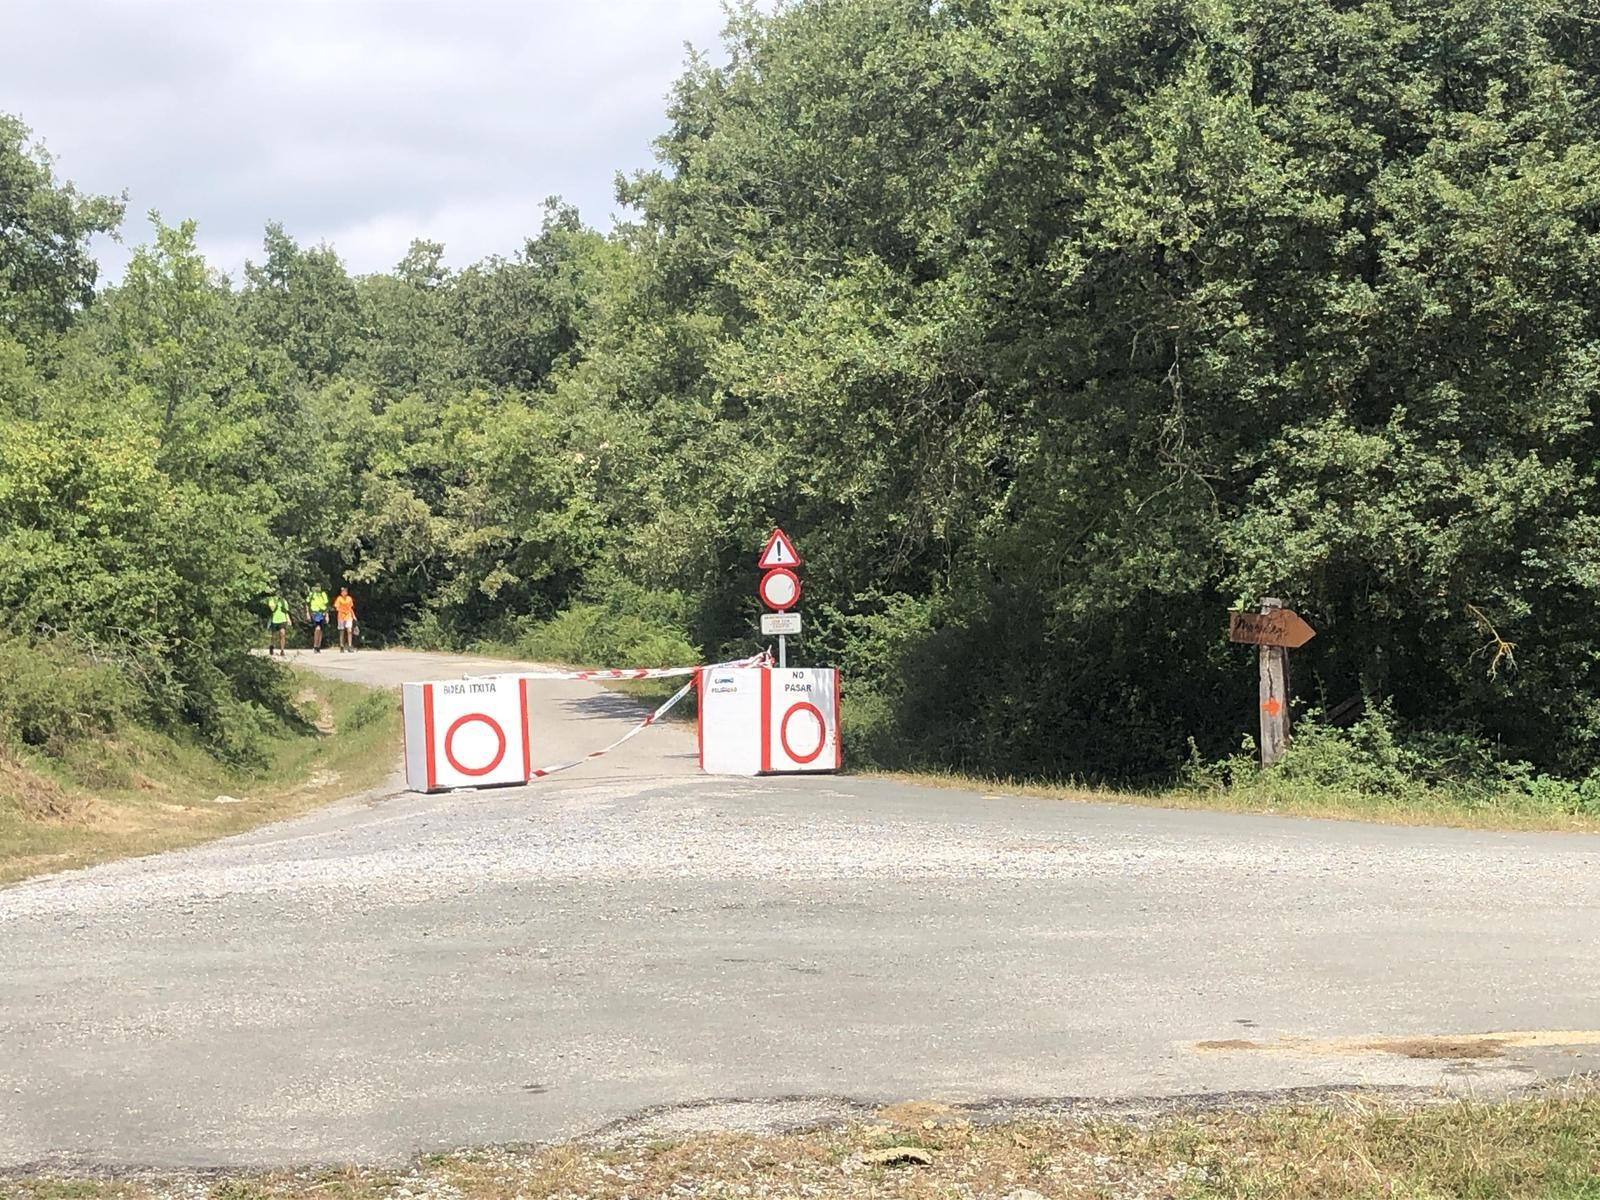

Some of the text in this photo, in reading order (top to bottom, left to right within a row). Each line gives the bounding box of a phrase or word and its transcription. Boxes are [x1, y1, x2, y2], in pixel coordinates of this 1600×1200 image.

[792, 671, 804, 679] NO
[714, 677, 734, 685] CNO
[443, 683, 496, 694] BIDEA ITXITA
[784, 684, 812, 692] PASAR
